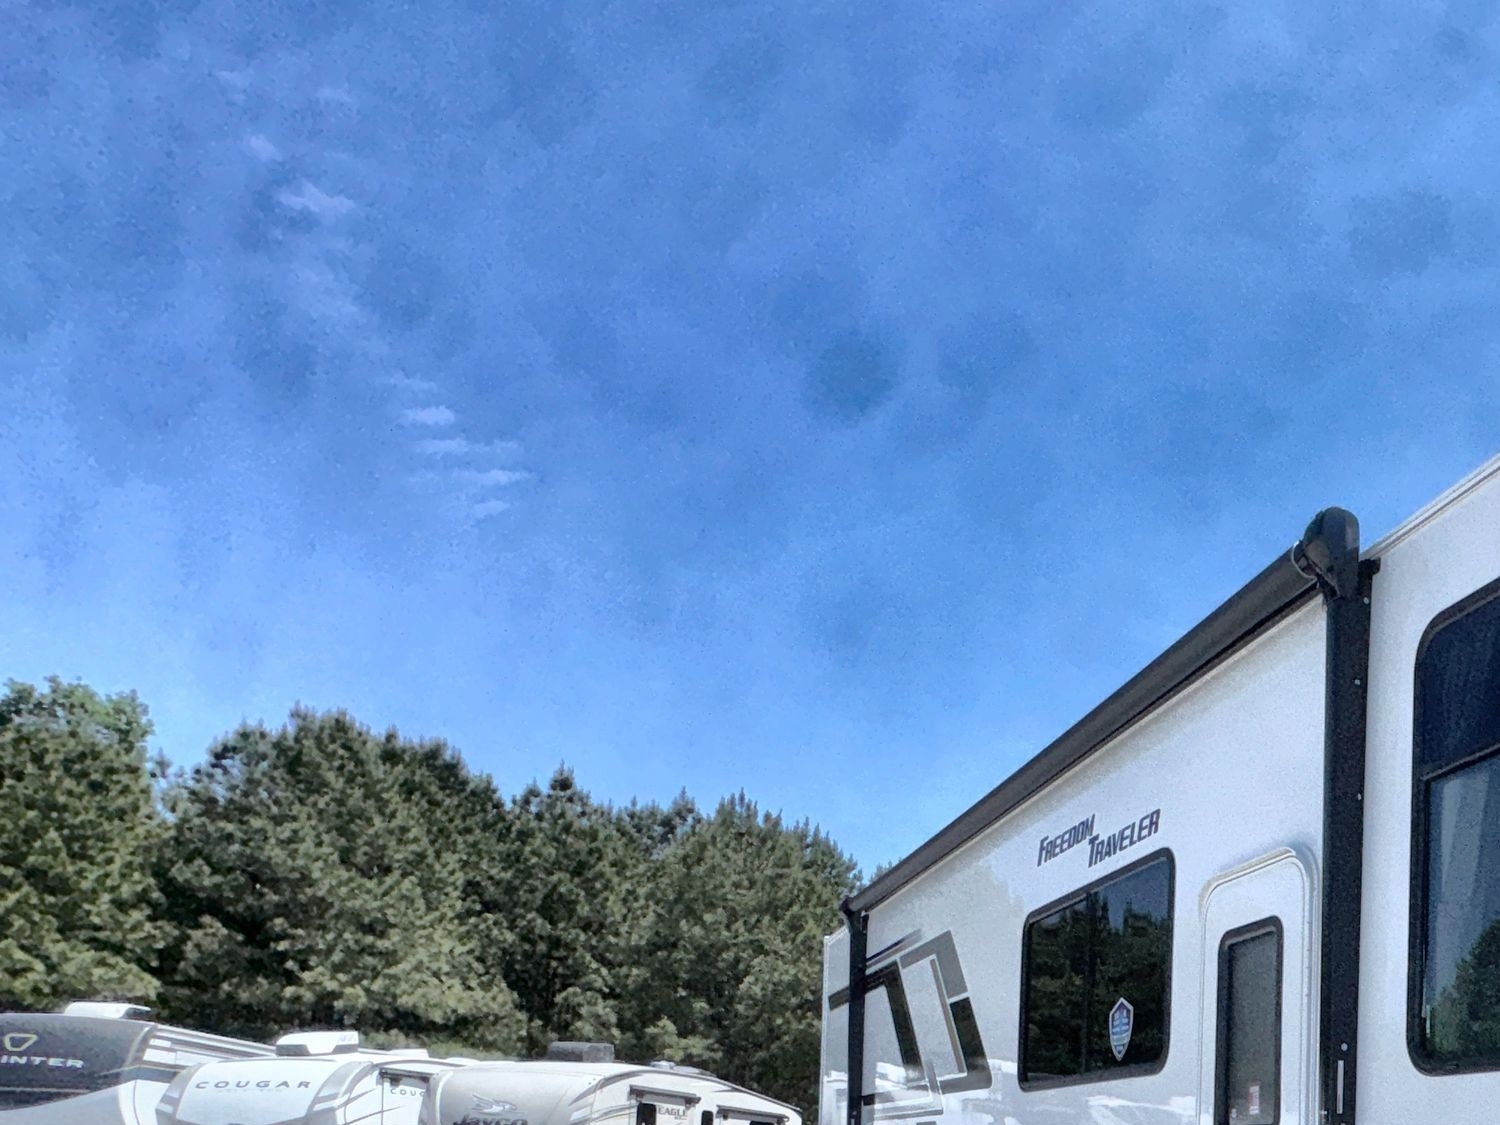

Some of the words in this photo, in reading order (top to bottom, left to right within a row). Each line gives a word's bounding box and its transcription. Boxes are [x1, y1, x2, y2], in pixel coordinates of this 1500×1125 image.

[1037, 813, 1096, 868] FREEDOM
[1088, 808, 1161, 869] TRAVELER
[195, 1080, 311, 1090] COUGAR
